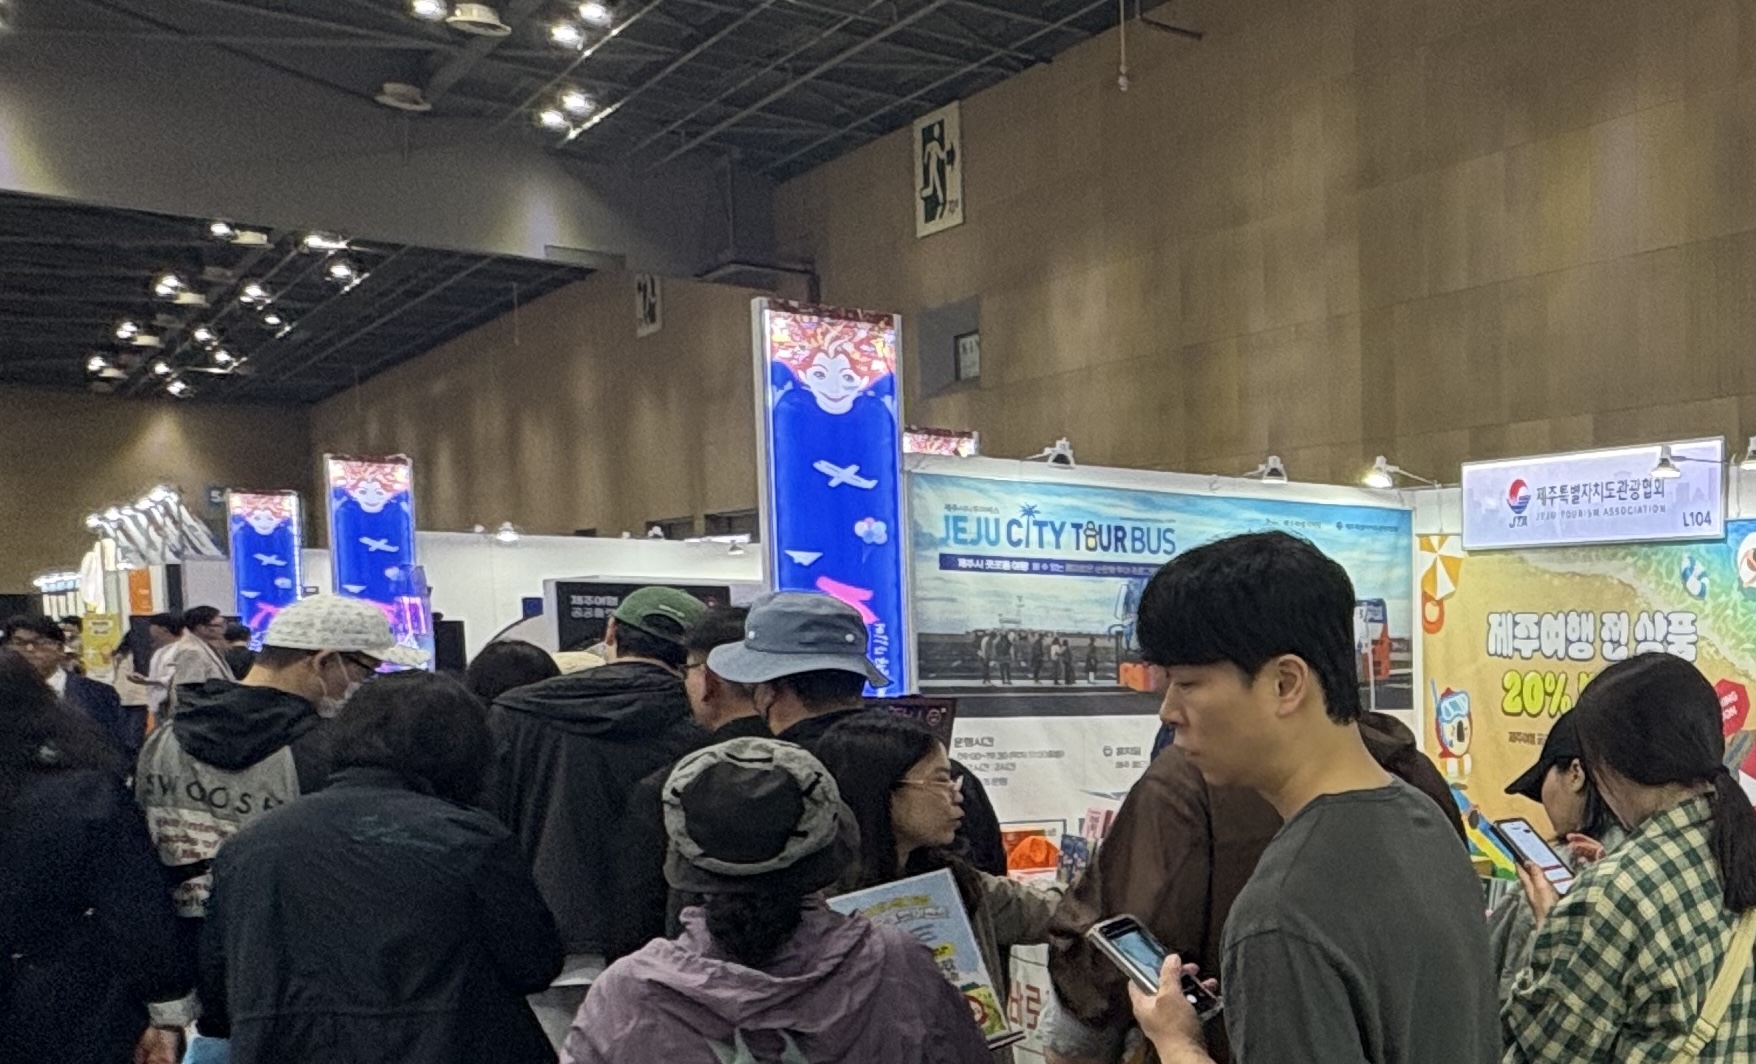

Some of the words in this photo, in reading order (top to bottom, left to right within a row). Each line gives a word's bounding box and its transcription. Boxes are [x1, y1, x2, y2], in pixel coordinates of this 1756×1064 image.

[1536, 478, 1665, 507] 제주특별자치도관광협회
[1509, 516, 1528, 528] JTA
[1560, 507, 1600, 520] TOURISM
[1603, 503, 1666, 517] ASSOCIATION
[1683, 511, 1712, 527] L104
[937, 514, 1000, 547] JEJU
[1006, 508, 1066, 550] CITY
[1131, 526, 1177, 556] BUS
[1487, 610, 1596, 663] 제주여행
[1600, 610, 1630, 662] 전
[1634, 610, 1699, 663] 상품
[1501, 669, 1573, 719] 20%
